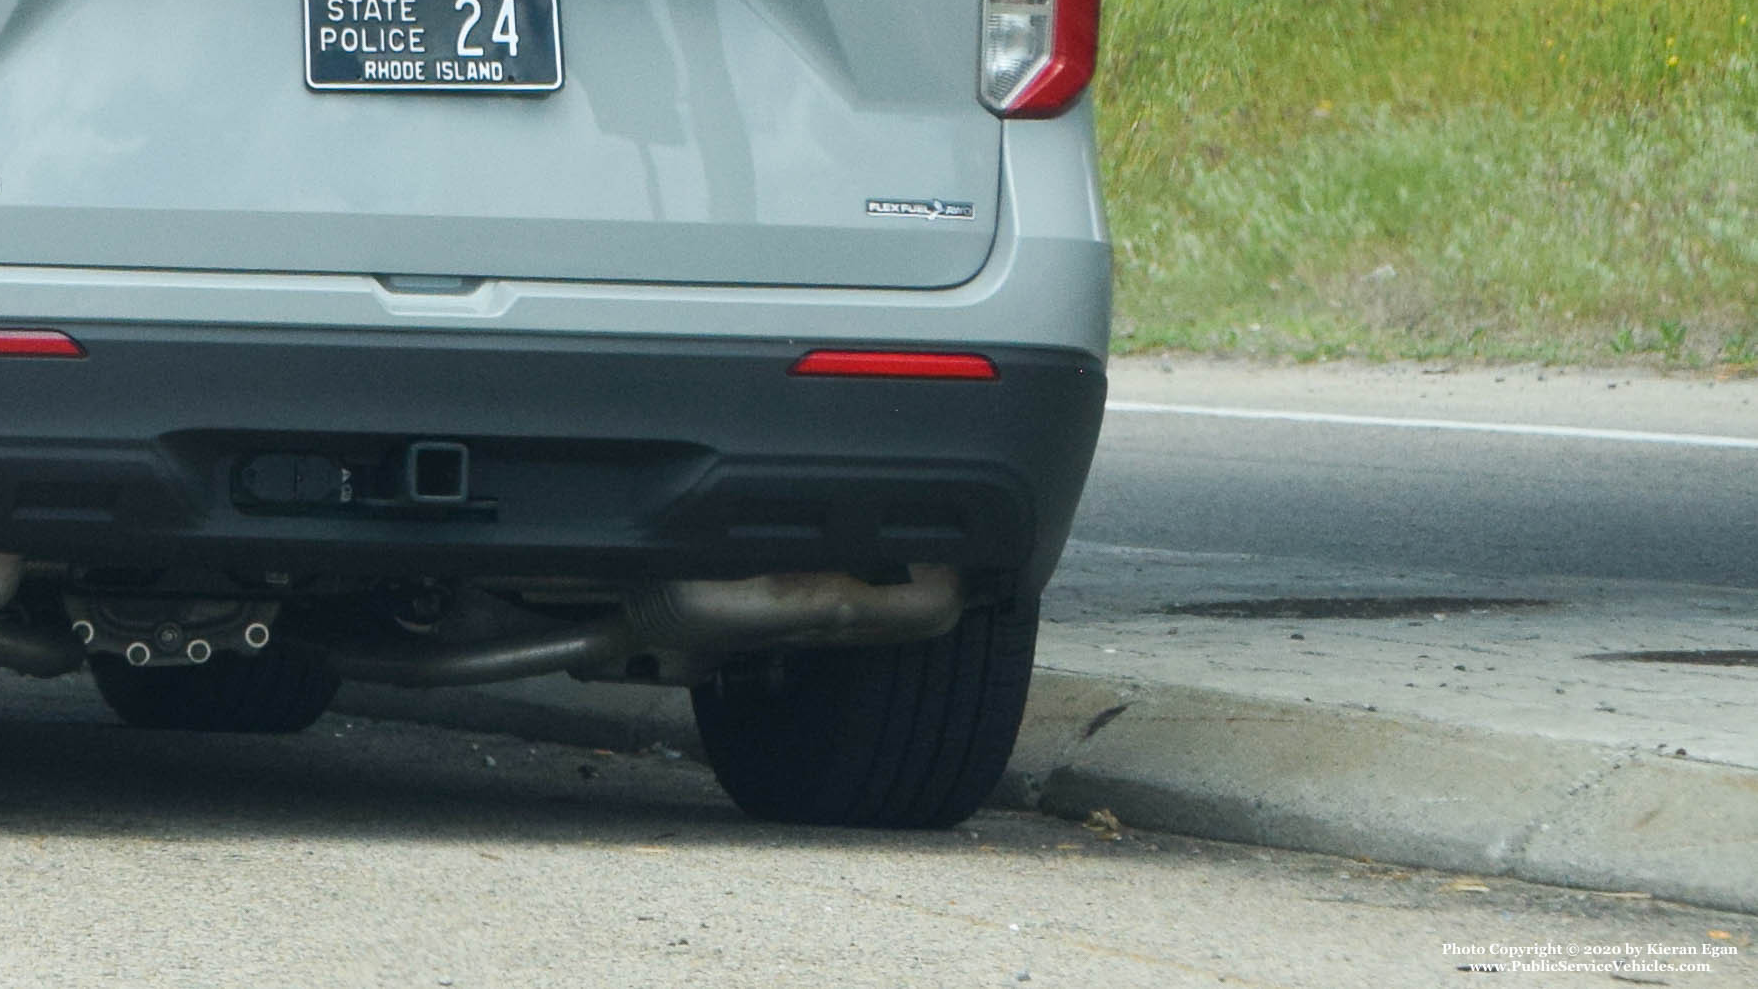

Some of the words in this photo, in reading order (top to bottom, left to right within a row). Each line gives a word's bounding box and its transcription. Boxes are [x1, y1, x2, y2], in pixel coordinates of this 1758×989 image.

[320, 27, 425, 52] POLICE
[365, 60, 426, 81] RHODE
[436, 61, 504, 81] ISLAND
